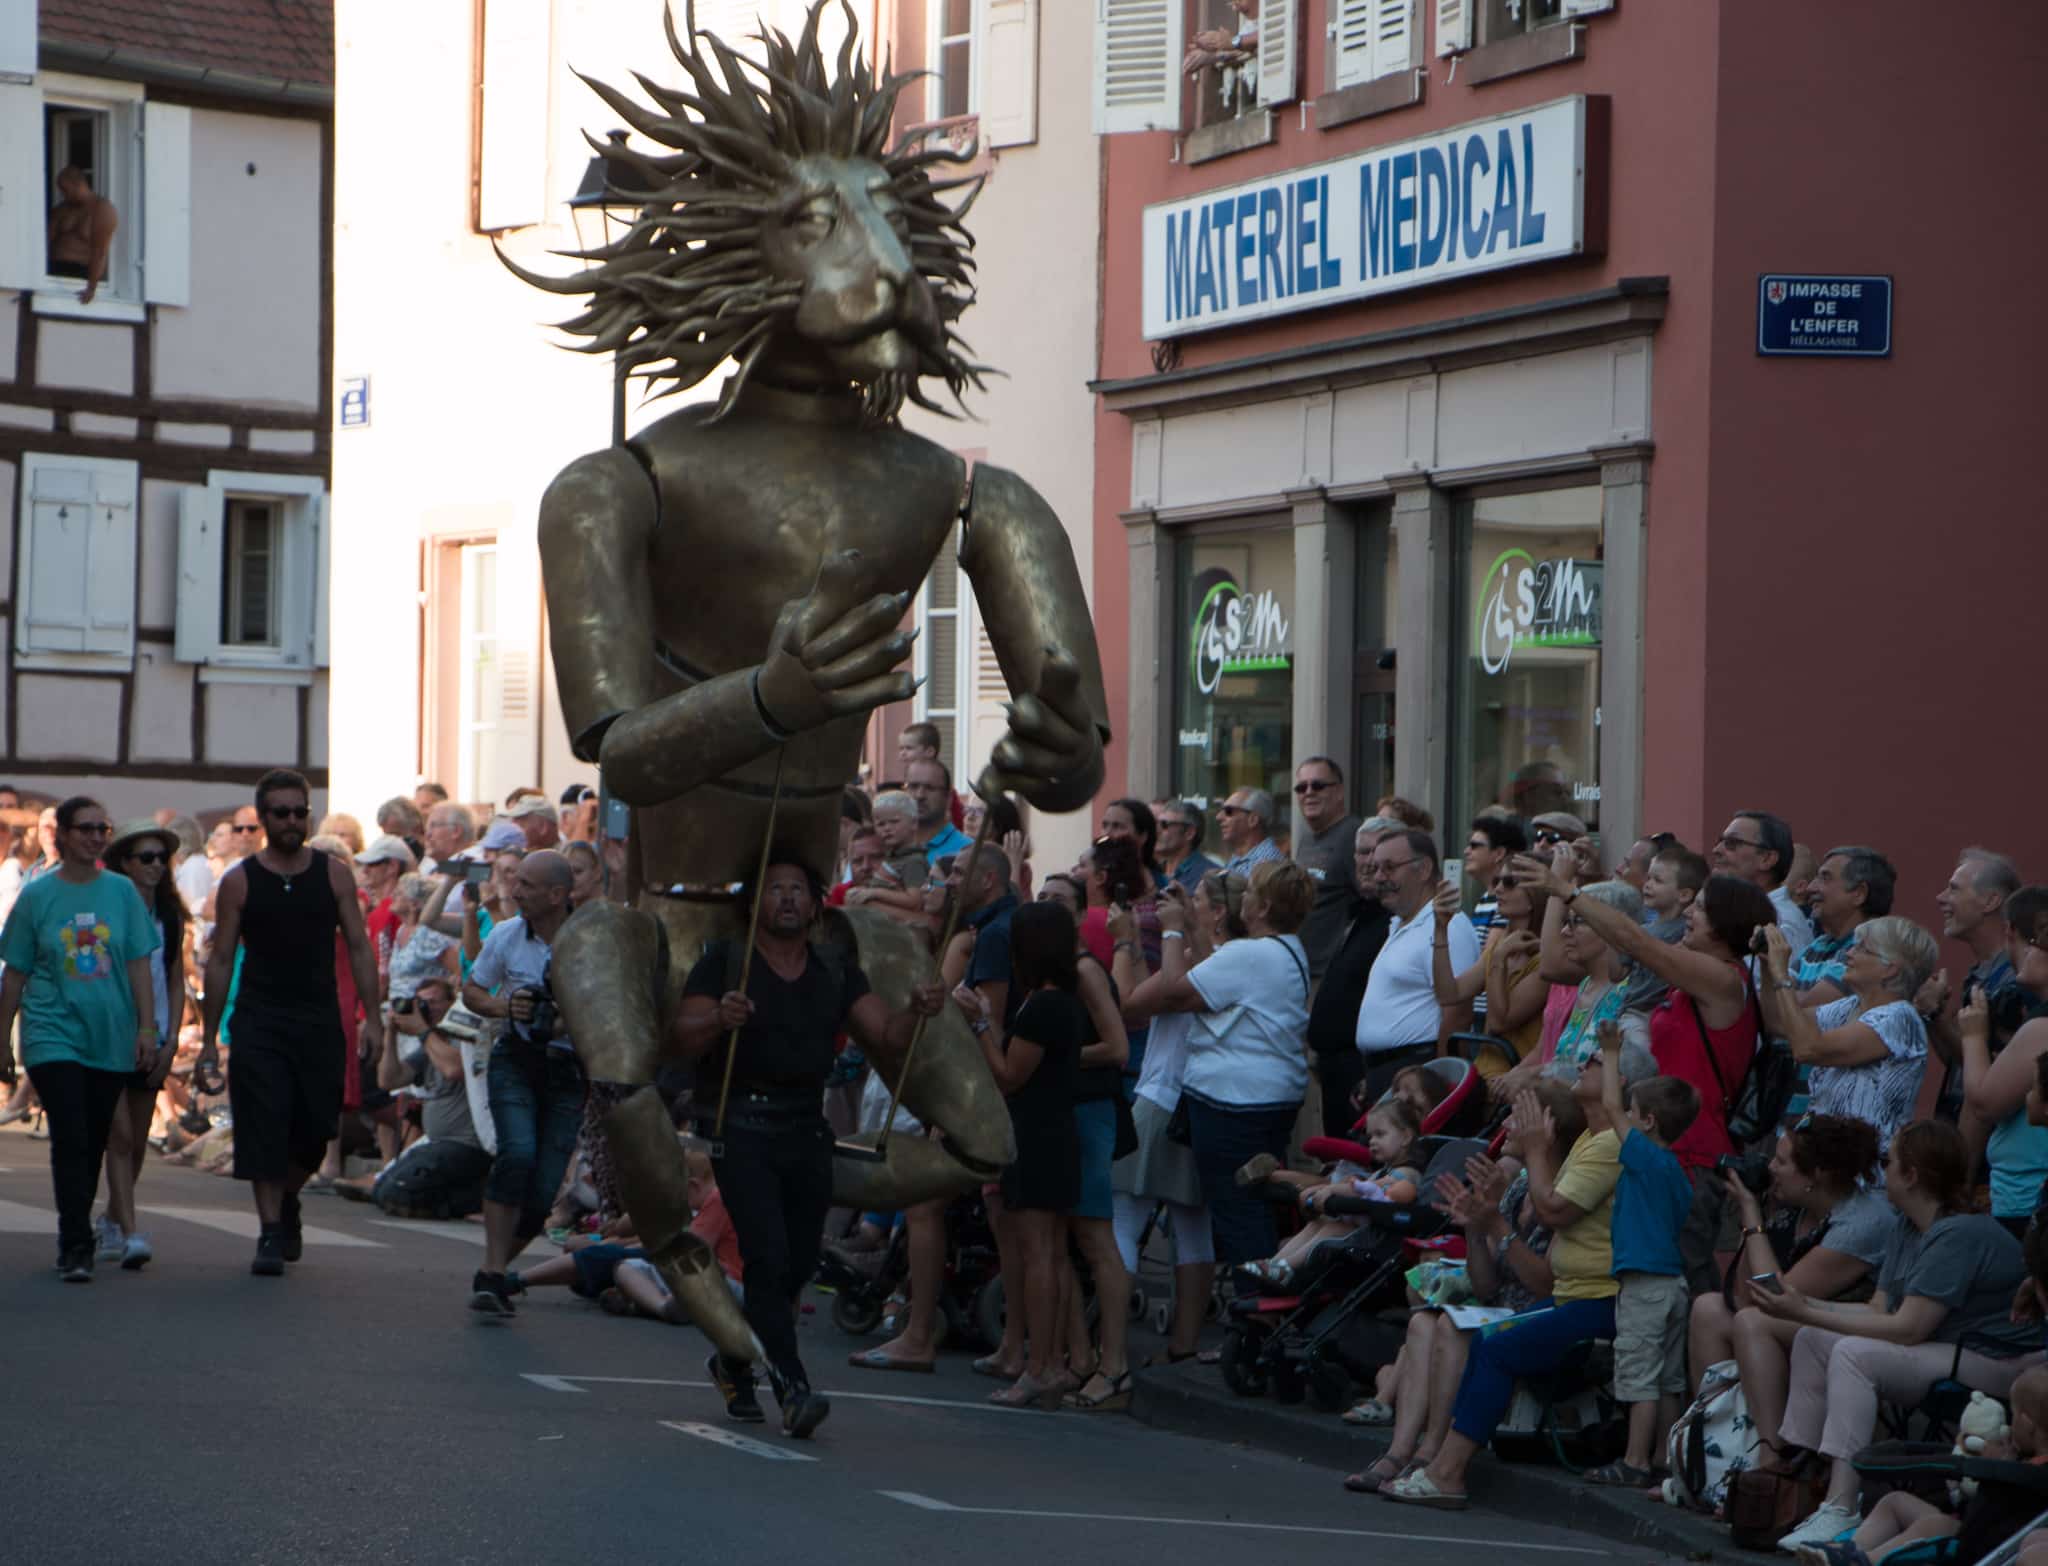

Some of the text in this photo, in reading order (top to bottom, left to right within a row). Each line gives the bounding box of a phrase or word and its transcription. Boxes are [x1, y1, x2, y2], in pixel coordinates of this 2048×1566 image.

[1165, 122, 1546, 323] MATERIEL MEDICAL
[1790, 282, 1863, 298] IMPASSE
[1814, 301, 1838, 316] DE
[1790, 318, 1860, 334] L'ENFER
